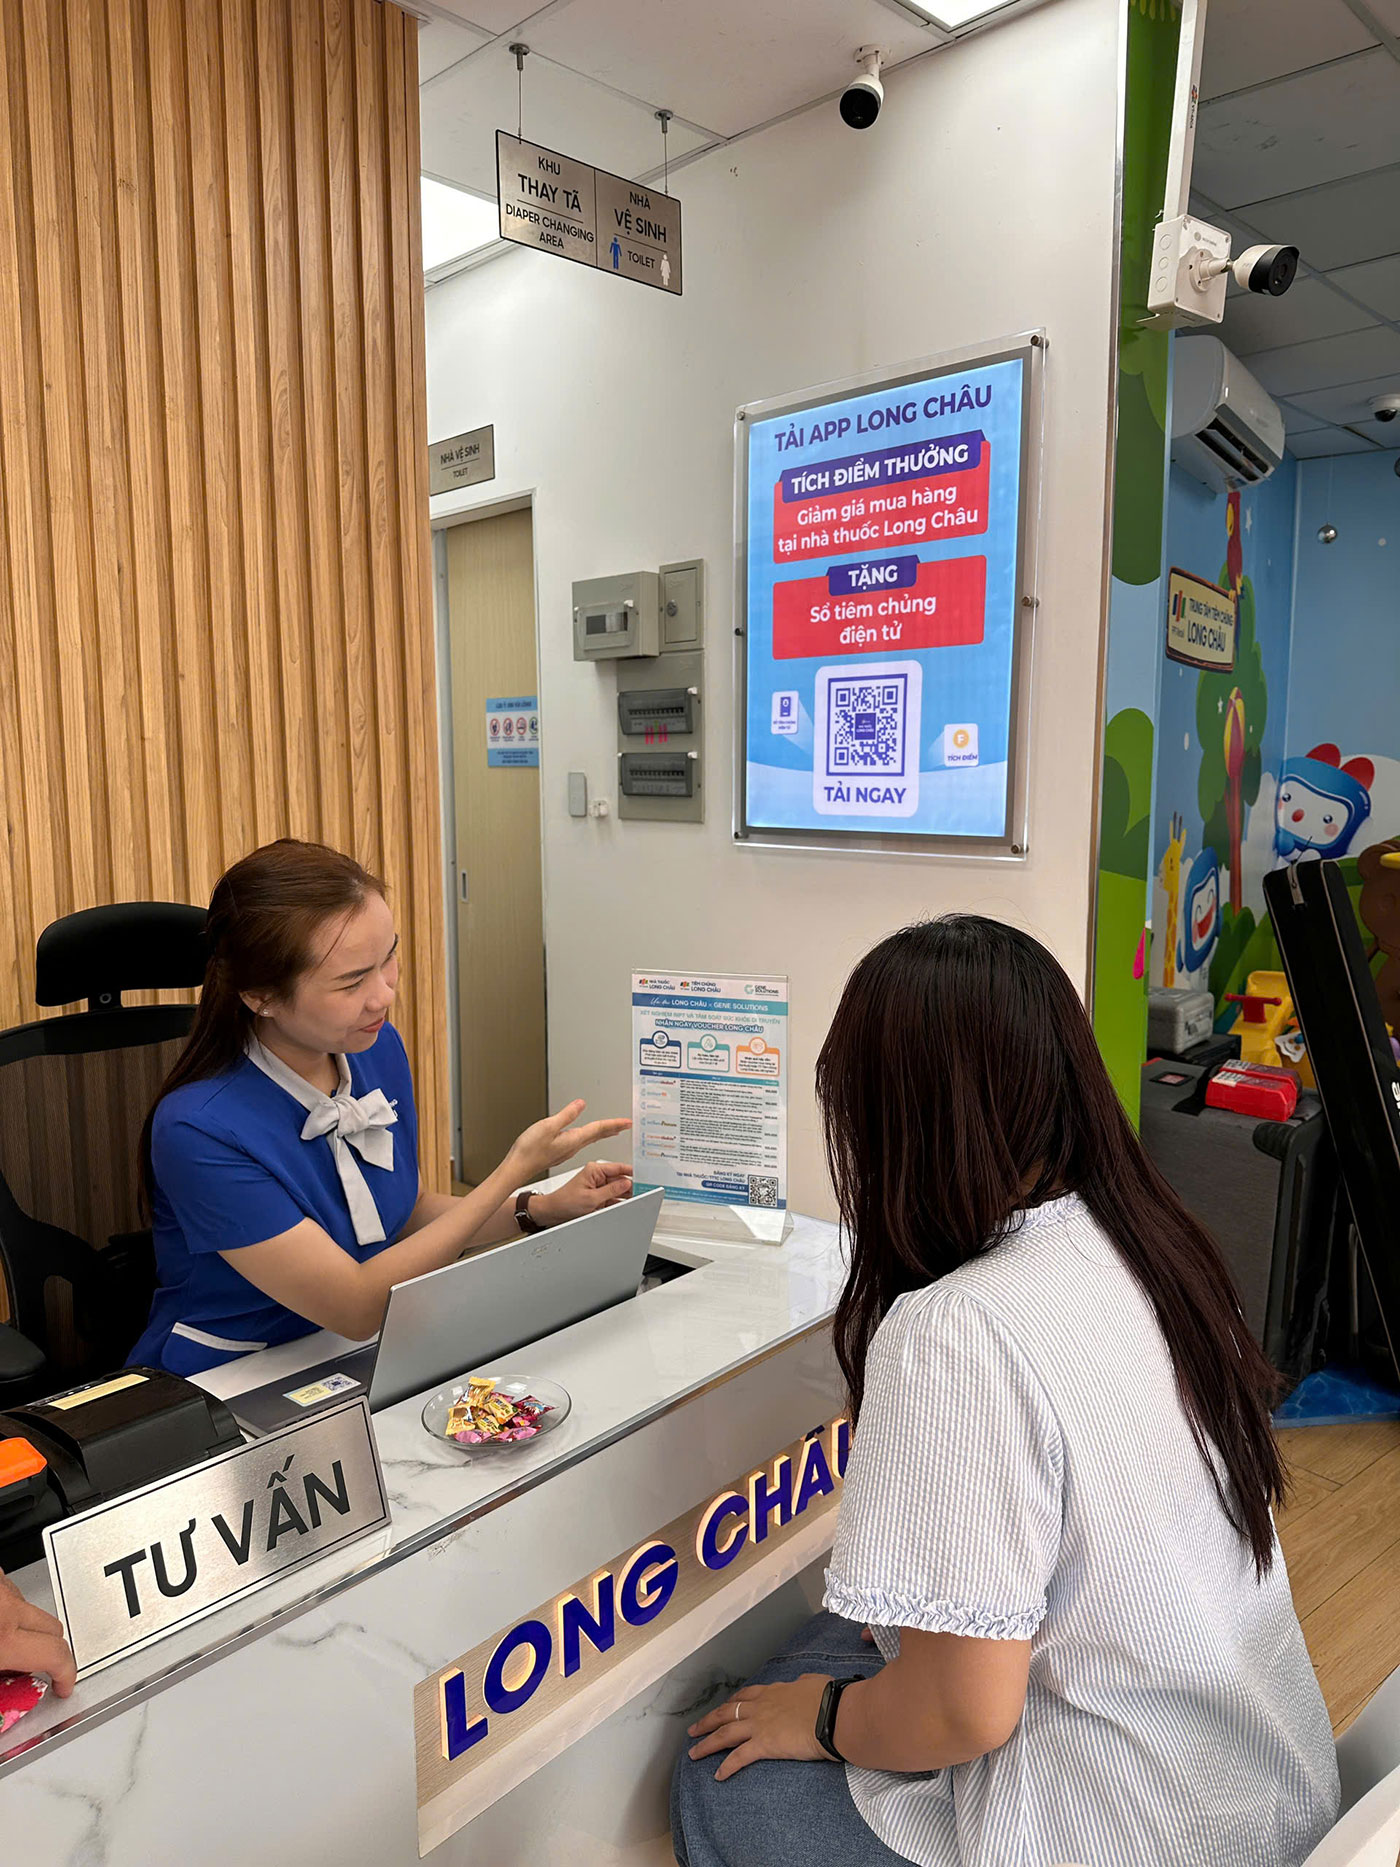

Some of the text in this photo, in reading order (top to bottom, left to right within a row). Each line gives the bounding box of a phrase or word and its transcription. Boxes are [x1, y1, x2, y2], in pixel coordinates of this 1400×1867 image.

[538, 156, 561, 175] KHU
[518, 173, 582, 213] THAY TÃ
[629, 191, 651, 211] NHÀ
[506, 203, 594, 243] DIAPER CHANGING
[614, 208, 667, 243] VỆ SINH
[539, 232, 564, 249] AREA
[627, 250, 655, 269] TOILET
[774, 384, 992, 452] TẢI APP LONG CHÂU
[440, 443, 480, 465] NHÀ VỆ SINH
[791, 443, 969, 494] TÍCH ĐIỂM THƯỞNG
[797, 485, 957, 526] Giảm giá mua hàng
[778, 507, 979, 556] tại nhà thuốc Long Châu
[848, 563, 898, 591] TẶNG
[809, 593, 937, 623] Sổ tiêm chủng
[839, 620, 903, 648] điện tử
[1187, 620, 1207, 647] LONG
[1208, 625, 1227, 652] CHÂU
[823, 780, 907, 804] TẢI NGAY
[733, 1003, 768, 1011] SOLUTIONS
[693, 1022, 723, 1030] VOUCHER
[744, 1024, 764, 1032] CHÂU
[103, 1453, 351, 1619] TƯ VẤN
[440, 1540, 679, 1762] LONG
